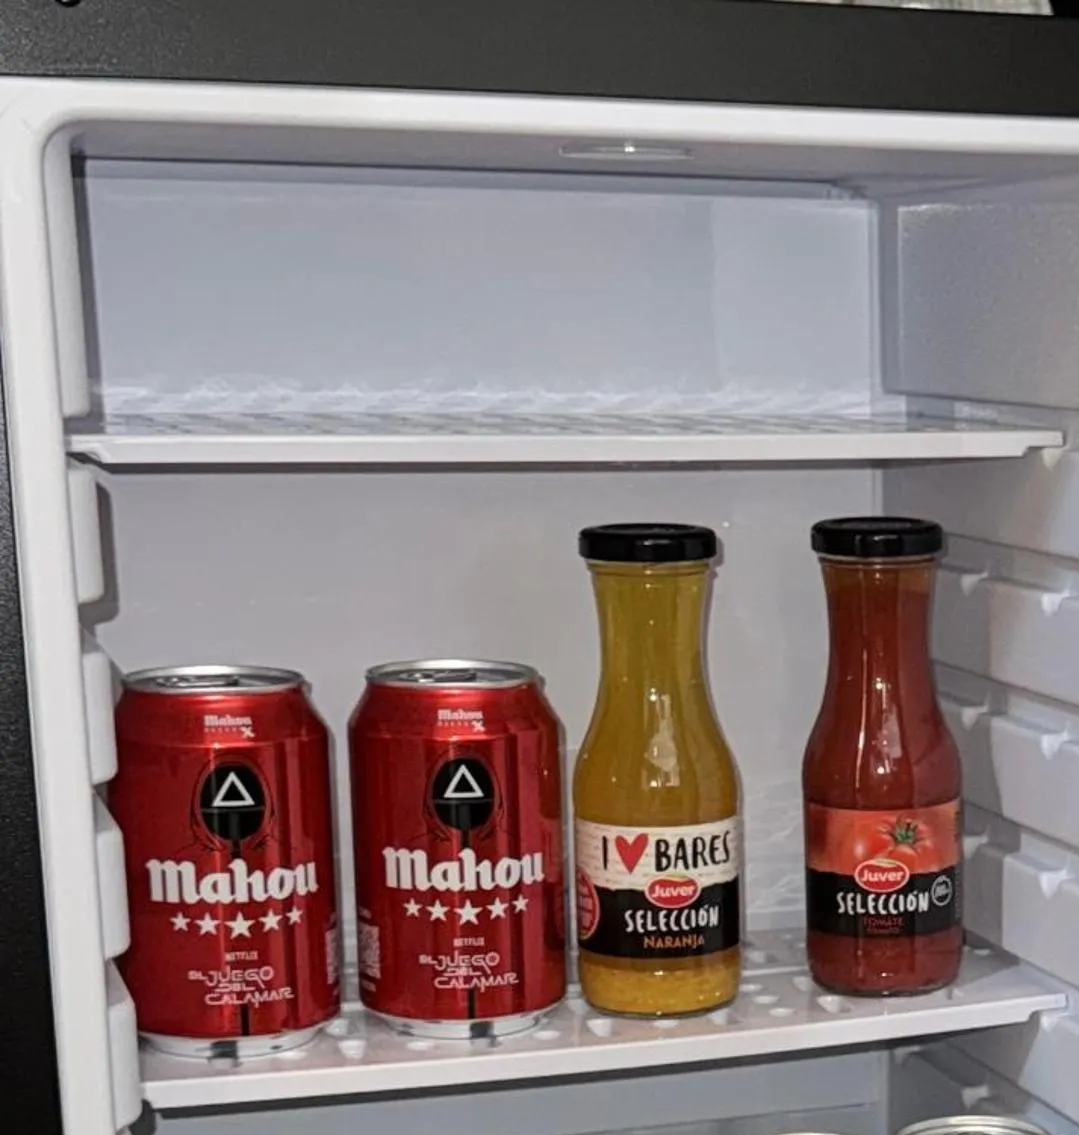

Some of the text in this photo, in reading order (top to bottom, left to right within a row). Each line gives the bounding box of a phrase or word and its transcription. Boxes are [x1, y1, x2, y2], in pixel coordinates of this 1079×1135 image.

[602, 830, 731, 873] I BARES
[146, 858, 318, 904] Mahou
[383, 847, 545, 892] Mahou
[861, 869, 905, 882] Juver
[651, 884, 696, 899] Juver
[836, 890, 930, 915] SELECCIÓN
[624, 904, 720, 934] SELECCIÓN
[643, 934, 706, 949] NARANJA
[434, 950, 500, 975] JUEGO
[206, 964, 275, 989] JUEGO
[434, 972, 519, 993] CALAMAR
[204, 987, 295, 1009] CALAMAR
